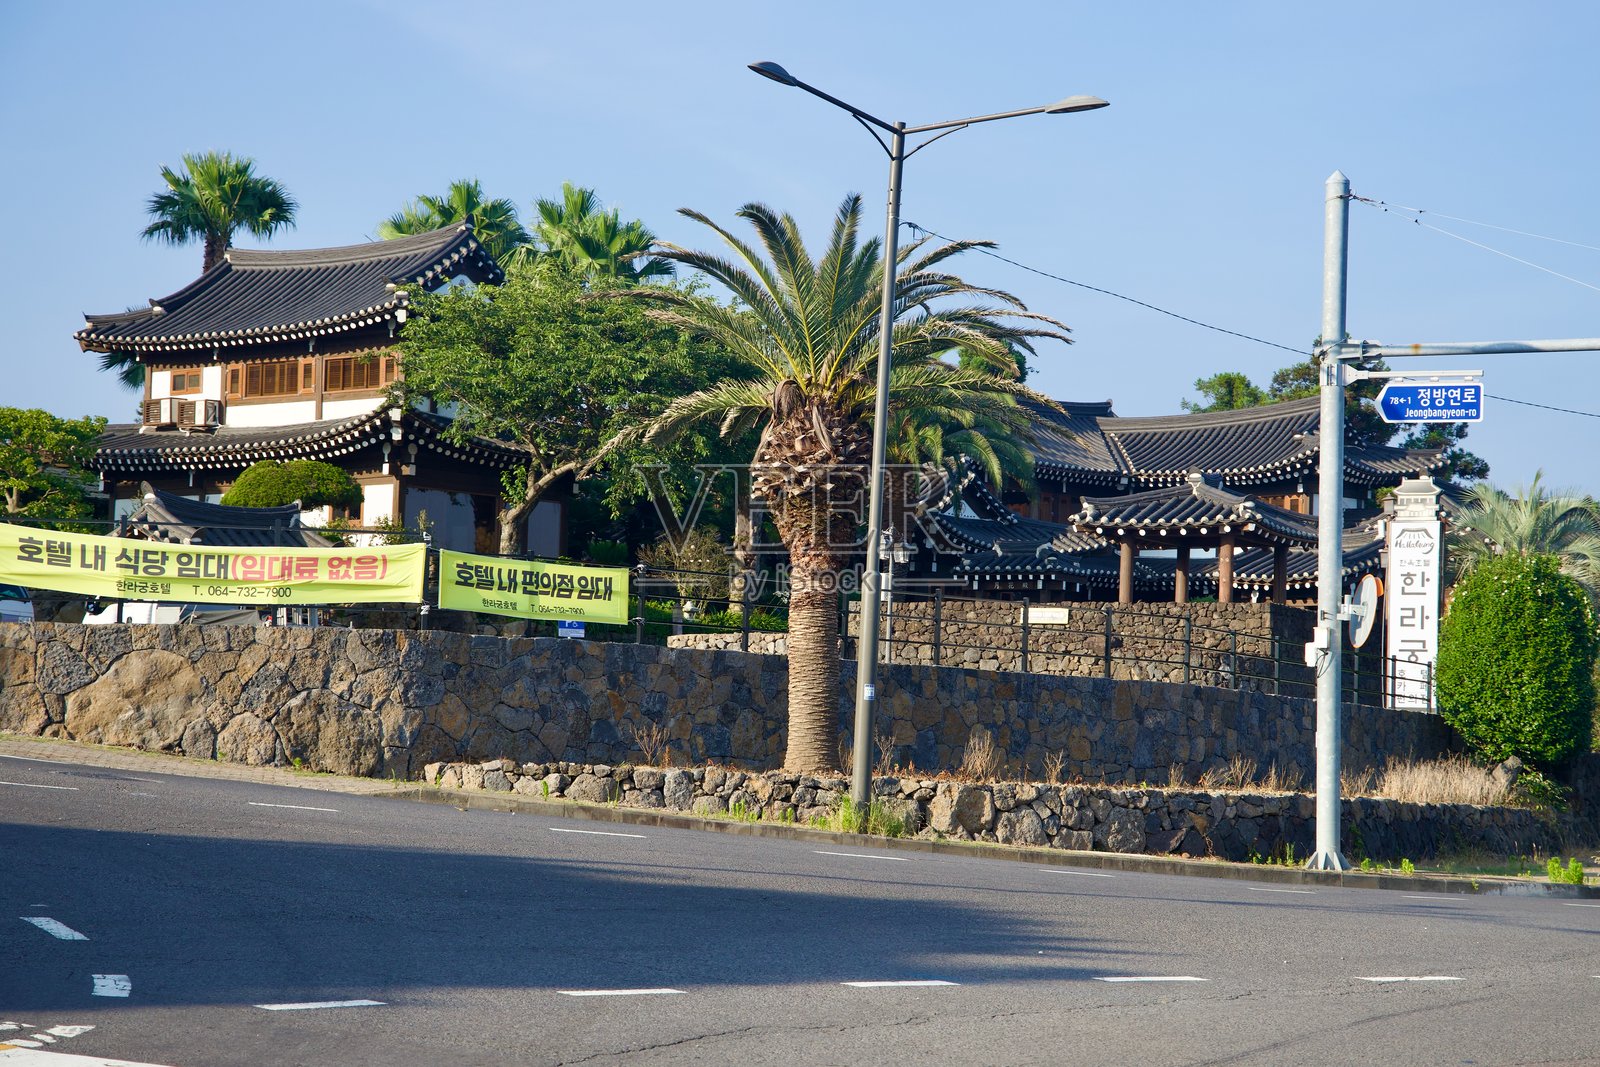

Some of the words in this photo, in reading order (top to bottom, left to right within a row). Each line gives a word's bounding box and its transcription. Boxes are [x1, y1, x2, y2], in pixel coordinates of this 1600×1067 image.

[1389, 396, 1399, 405] 78
[1417, 388, 1477, 407] 정방연로
[1404, 408, 1477, 419] Jeongbangyeon-ro
[16, 535, 73, 568] 호텔
[80, 543, 106, 572] 내
[114, 546, 170, 577] 식당
[327, 553, 388, 581] 없음)
[116, 579, 171, 595] 한라궁호텔
[193, 585, 204, 597] T.
[208, 585, 292, 598] 064-732-7900
[455, 562, 494, 591] 호텔
[497, 568, 518, 593] 내
[521, 570, 574, 599] 편의점
[577, 575, 613, 601] 임대
[481, 598, 518, 611] 한라궁호텔
[538, 604, 586, 616] 064-732-7900
